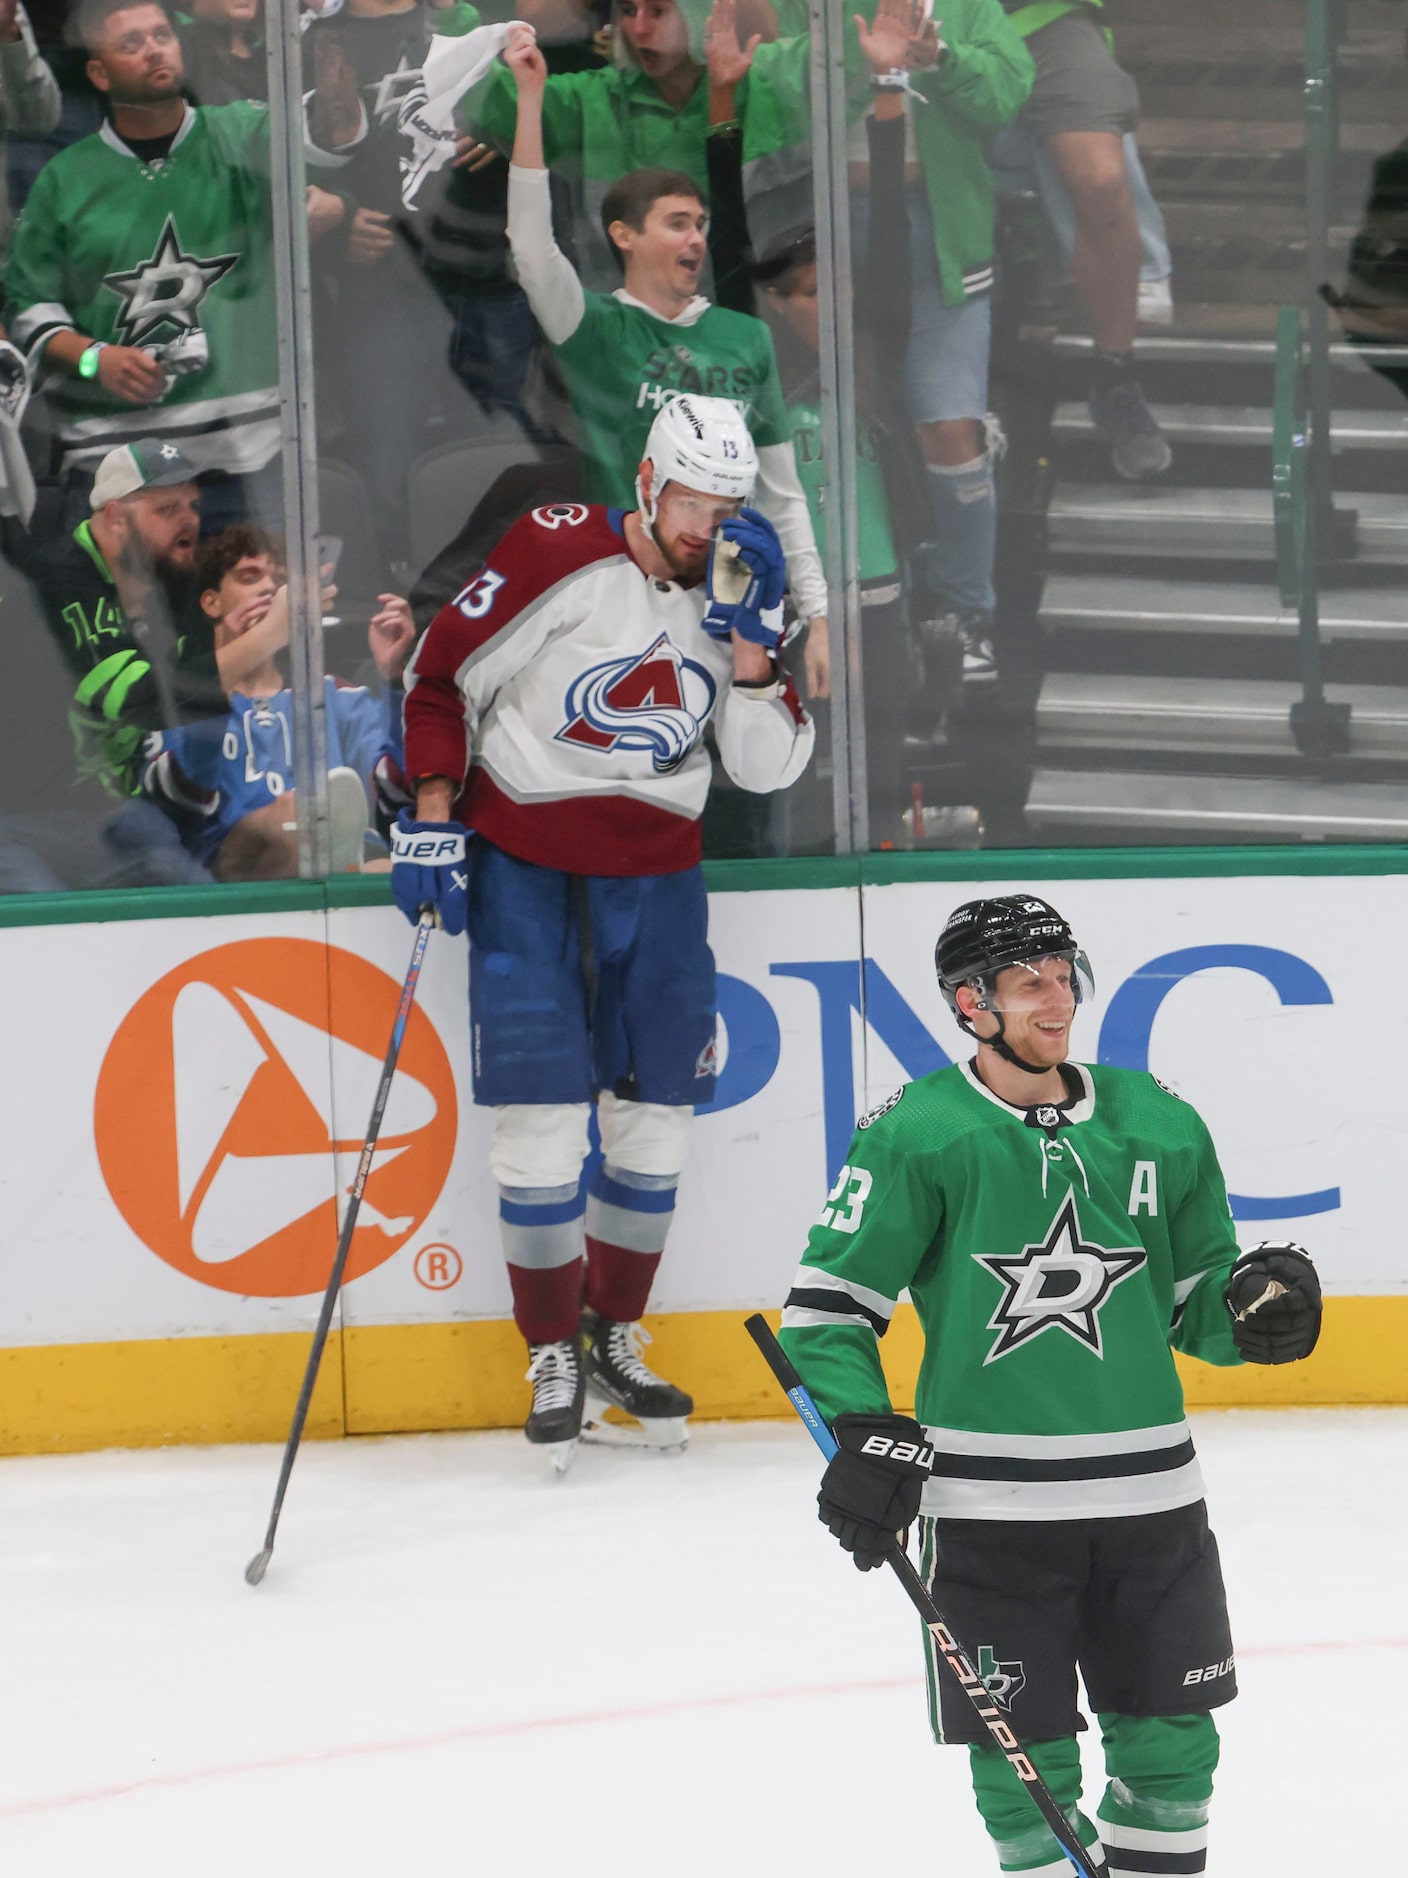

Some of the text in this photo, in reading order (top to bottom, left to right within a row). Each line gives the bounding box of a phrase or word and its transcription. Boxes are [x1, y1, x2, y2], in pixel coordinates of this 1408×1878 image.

[723, 440, 739, 460] 13
[394, 839, 458, 857] UER
[1029, 924, 1064, 936] CCM
[819, 1164, 874, 1235] 23
[1127, 1160, 1158, 1217] A
[789, 1386, 820, 1429] BAUER
[860, 1435, 935, 1472] BAU
[1182, 1654, 1236, 1687] BAUE
[926, 1621, 1039, 1783] BAUER
